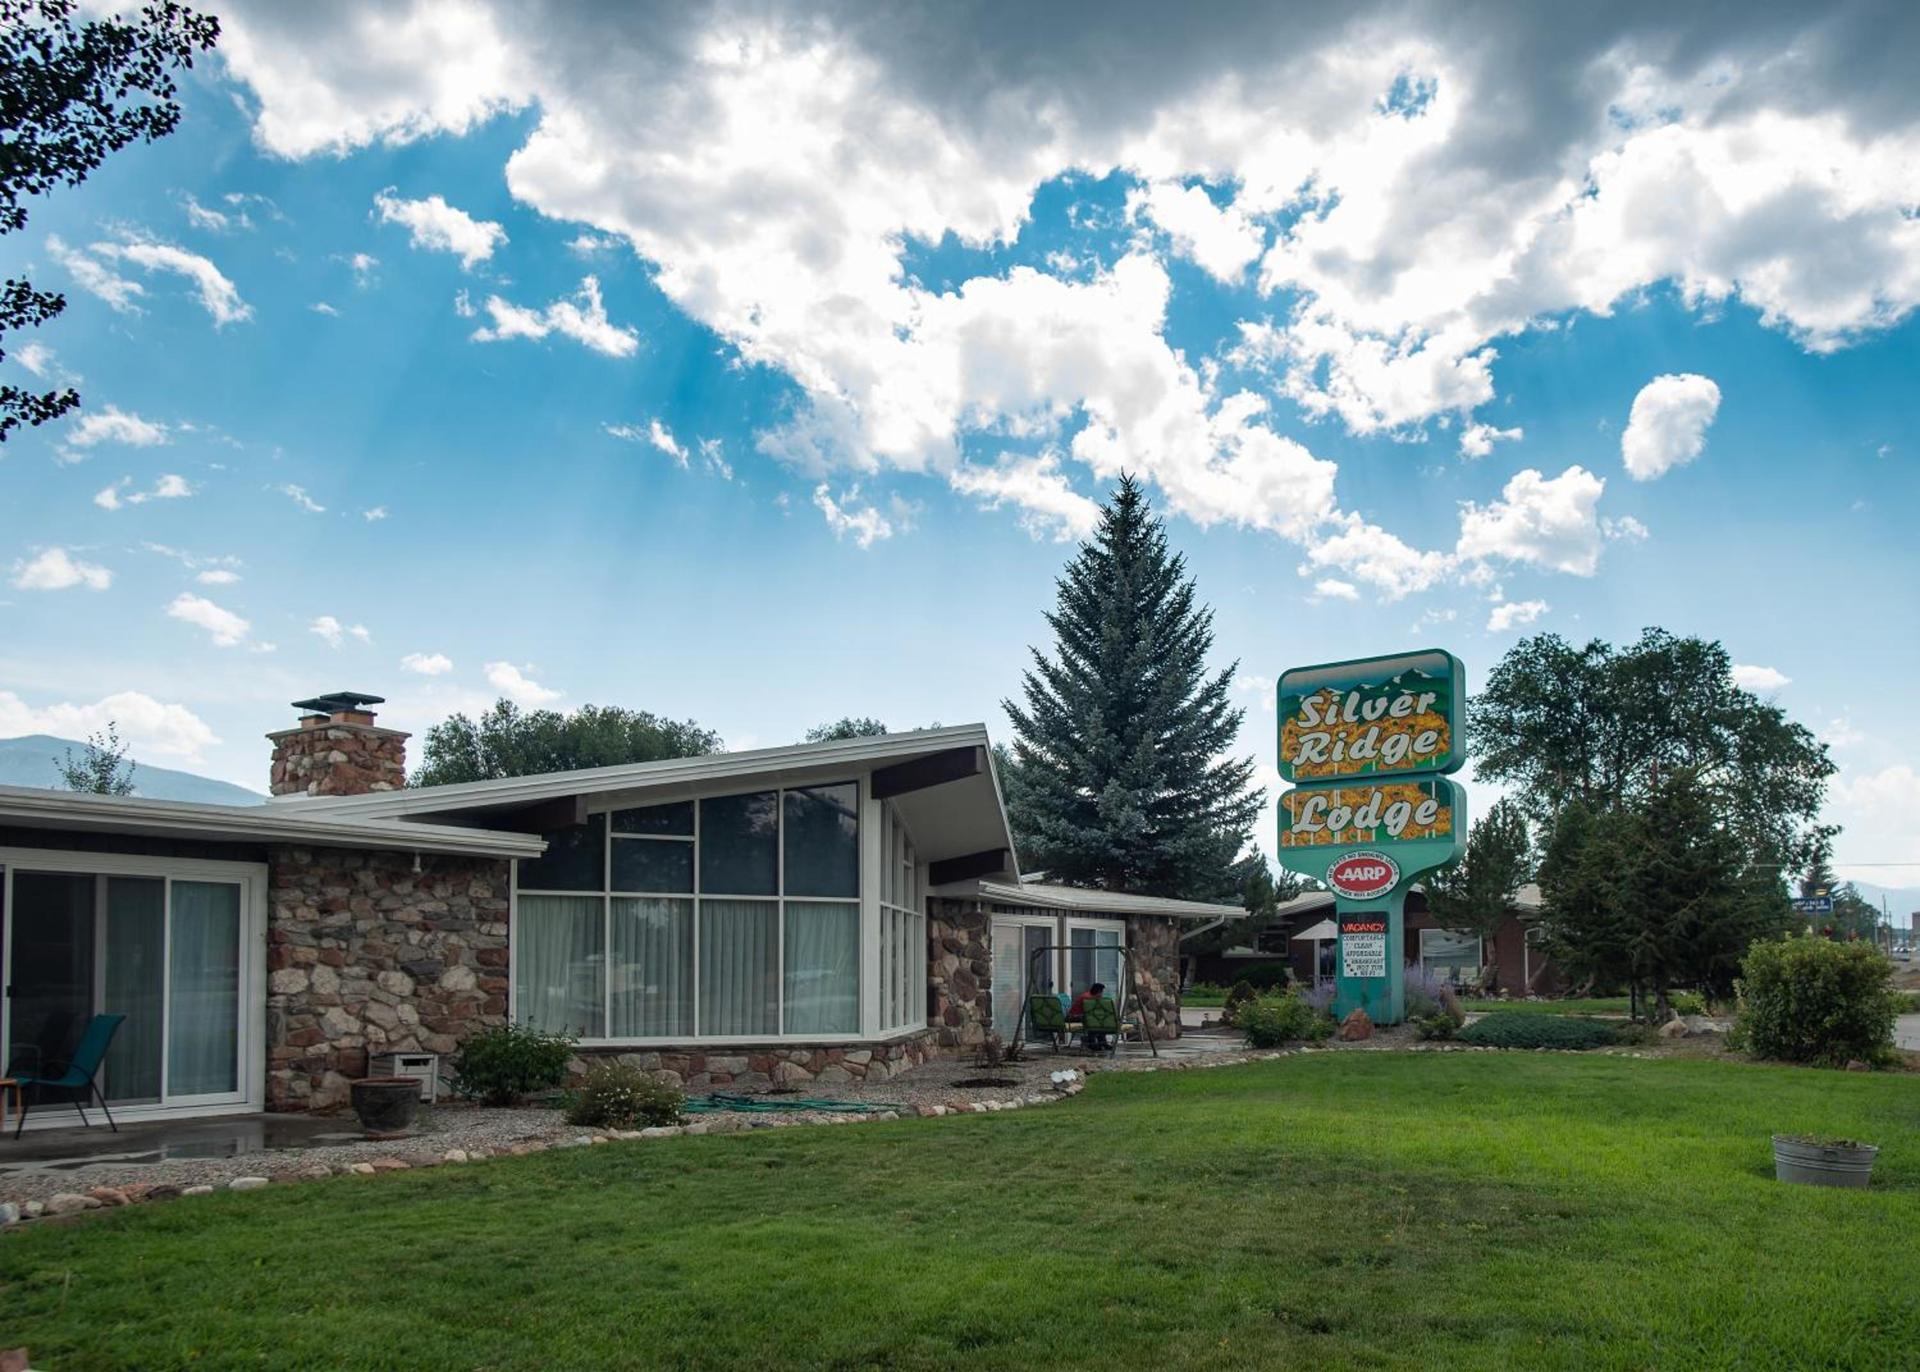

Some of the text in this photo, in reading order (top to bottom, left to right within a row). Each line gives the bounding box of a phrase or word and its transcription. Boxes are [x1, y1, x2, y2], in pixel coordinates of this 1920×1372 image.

[1297, 691, 1437, 728] Silver
[1292, 726, 1439, 765] Ridge
[1291, 791, 1439, 836] Lodge
[1337, 866, 1386, 881] AARP
[1342, 923, 1385, 932] VACANCY
